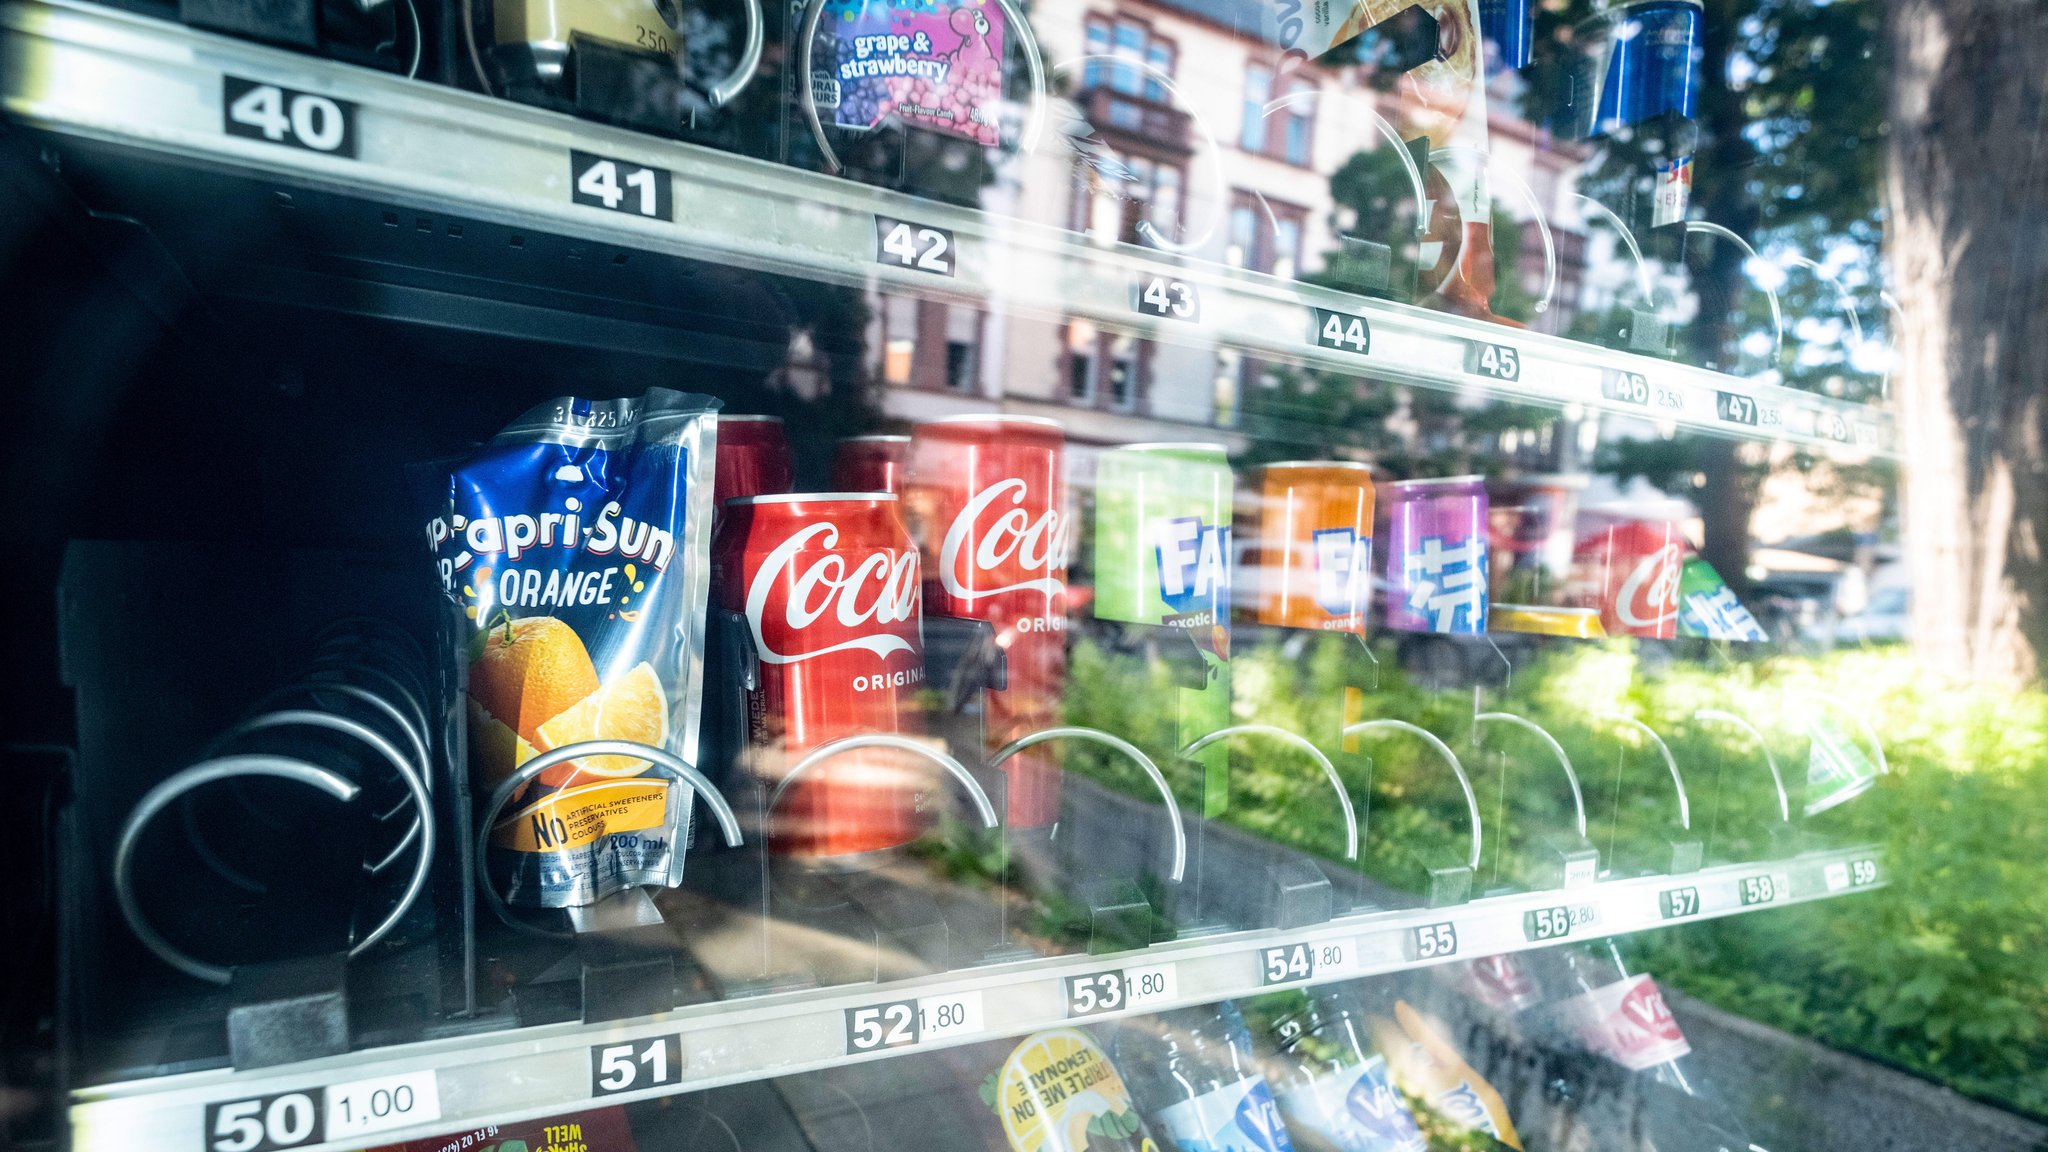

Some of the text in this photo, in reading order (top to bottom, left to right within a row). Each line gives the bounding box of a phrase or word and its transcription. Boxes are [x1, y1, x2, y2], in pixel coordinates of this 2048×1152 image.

[855, 31, 930, 59] grape &
[840, 54, 948, 83] strawberry
[231, 85, 345, 151] 40
[936, 108, 954, 121] Candy
[577, 160, 657, 217] 41
[882, 223, 949, 272] 42
[1143, 277, 1196, 318] 43
[1322, 313, 1369, 352] 44
[1480, 344, 1518, 380] 45
[1616, 372, 1648, 403] 46
[1728, 395, 1754, 423] 47
[499, 567, 619, 607] ORANGE
[1167, 612, 1211, 628] exotic
[566, 792, 664, 821] ARTIFICIAL SWEETENERS
[568, 806, 629, 831] PRESERVATIVES
[571, 820, 606, 841] COLOURS
[610, 834, 664, 850] 200 ml
[1854, 860, 1877, 885] 59
[1670, 887, 1696, 916] 57
[1747, 876, 1774, 903] 58
[1535, 906, 1595, 938] 56 2,80
[1418, 925, 1454, 957] 55
[1266, 947, 1342, 981] 54 1,80
[1073, 973, 1165, 1013] 53 1,80
[852, 1003, 965, 1049] 52 1,80
[600, 1040, 668, 1091] 51
[1012, 1060, 1110, 1124] TRIPLE MEON
[212, 1084, 415, 1152] 50 1,00
[488, 1125, 499, 1138] 16
[461, 1136, 473, 1149] OZ
[474, 1130, 485, 1142] FL
[543, 1124, 582, 1145] WELL
